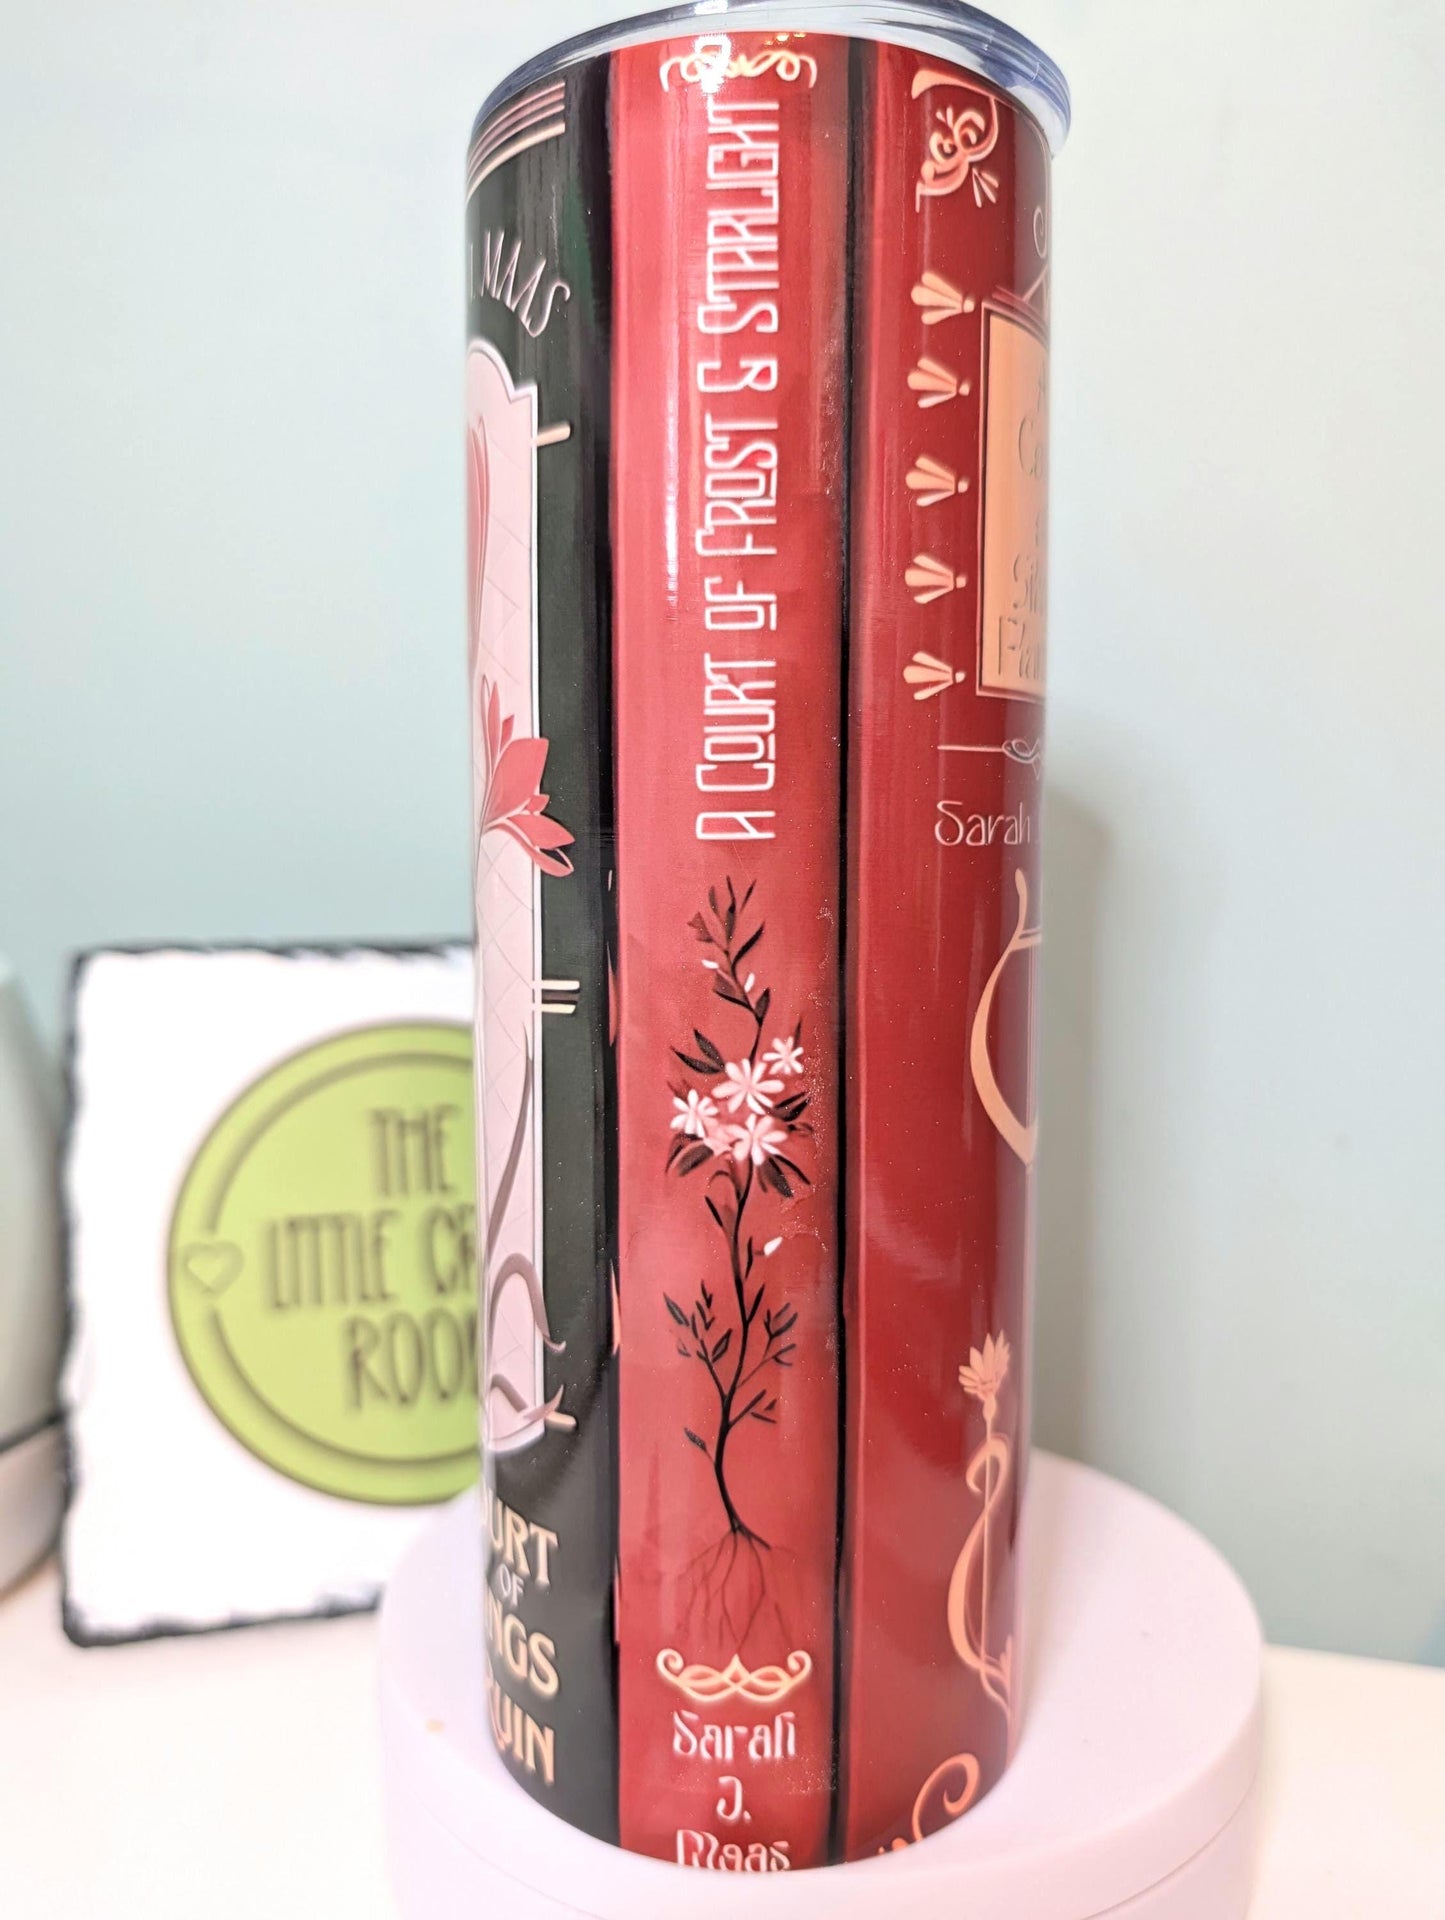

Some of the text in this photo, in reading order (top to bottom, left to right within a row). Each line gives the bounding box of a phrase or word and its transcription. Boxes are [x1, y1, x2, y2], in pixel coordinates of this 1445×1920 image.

[480, 230, 571, 338] MAAS
[697, 358, 779, 394] &
[695, 811, 777, 842] A
[934, 800, 1031, 847] Sarah
[367, 1104, 461, 1196] THE
[266, 1208, 402, 1310] LITTLE
[342, 1308, 478, 1411] ROO
[499, 1563, 525, 1606] OF
[672, 1709, 796, 1760] Sarah
[716, 1775, 751, 1822] J.
[676, 1829, 791, 1872] Maas
